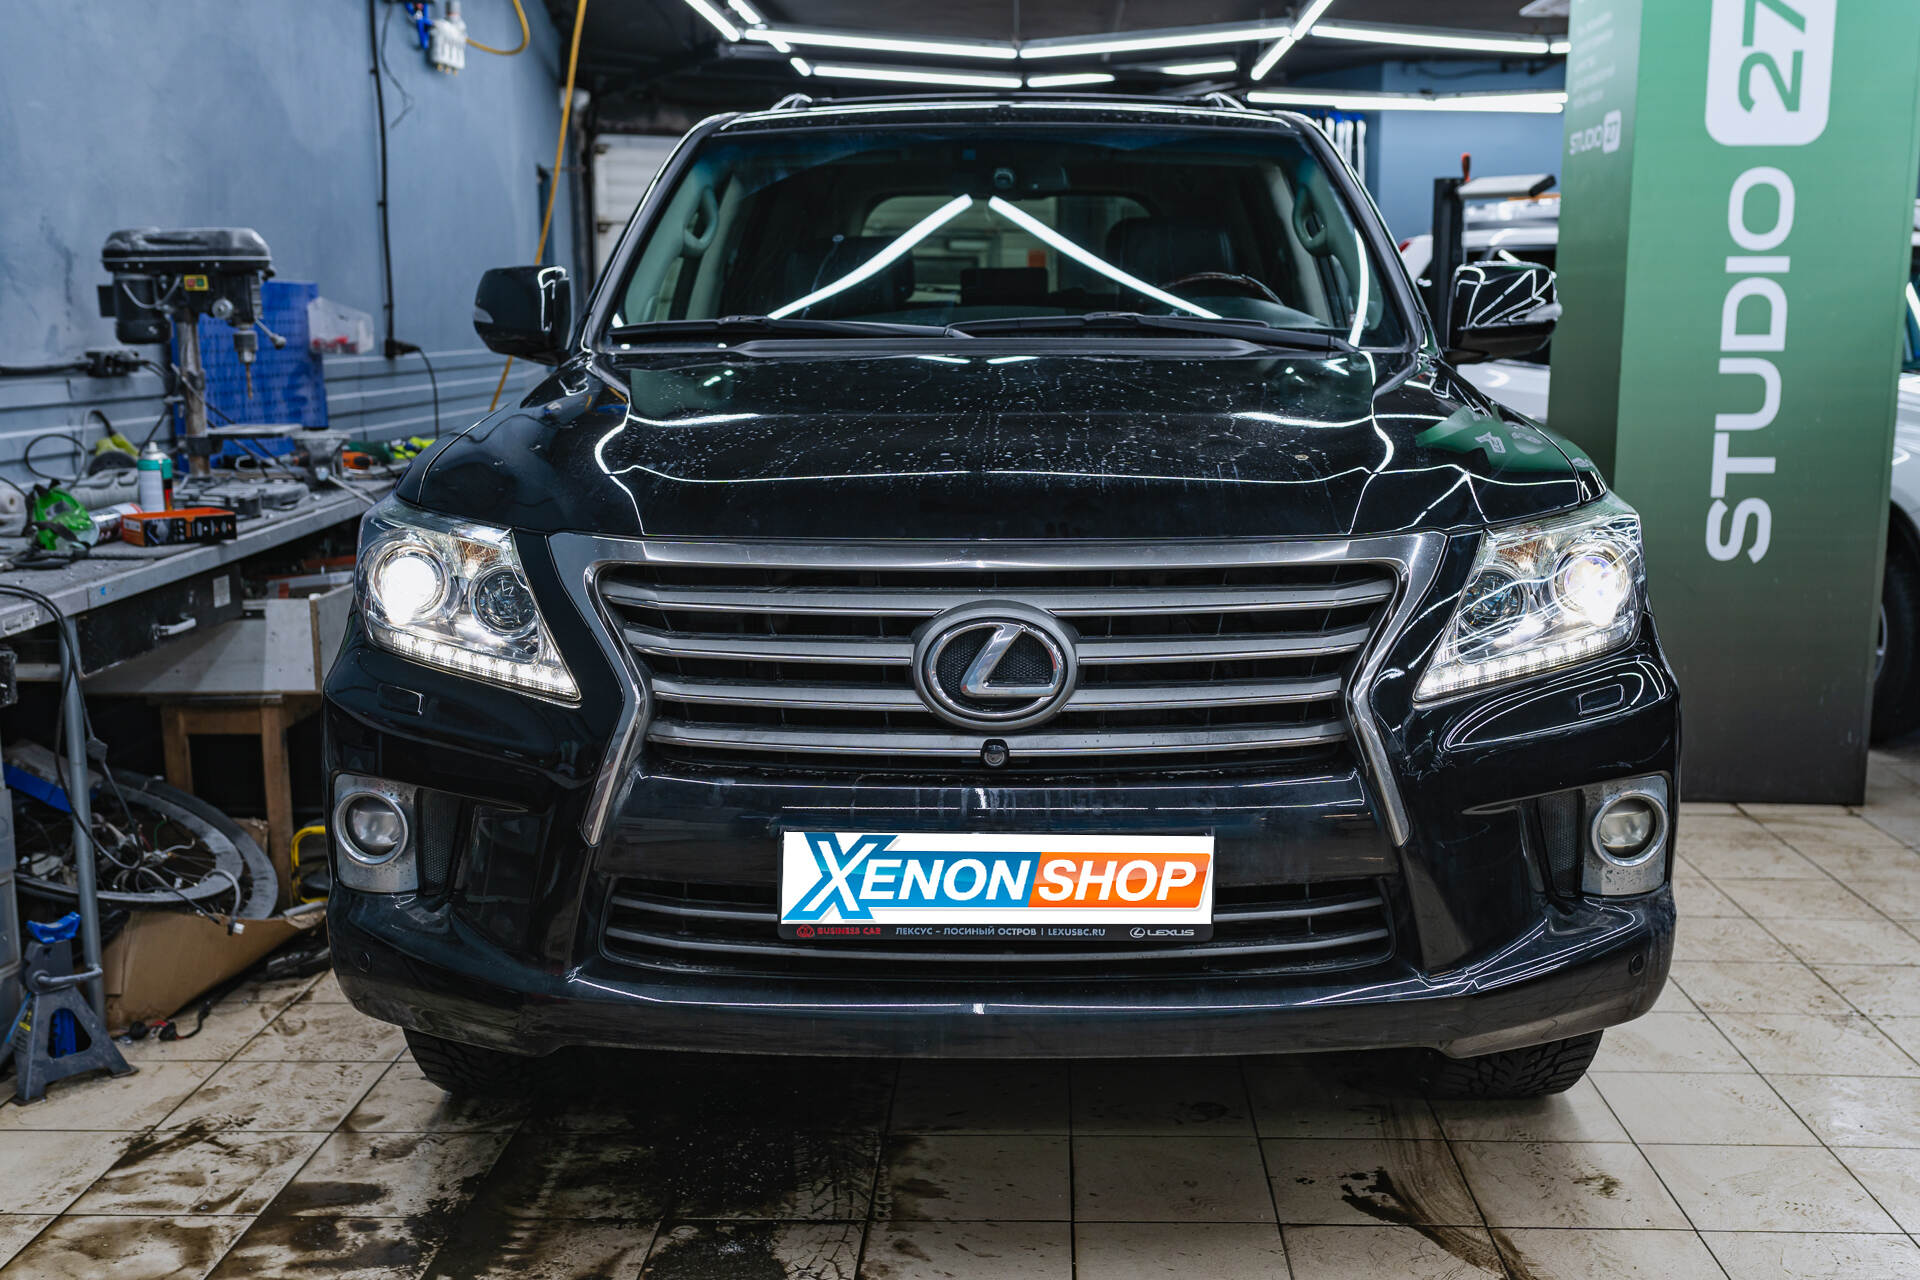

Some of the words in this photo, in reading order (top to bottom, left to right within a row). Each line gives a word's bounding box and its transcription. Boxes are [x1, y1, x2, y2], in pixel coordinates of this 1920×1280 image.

[1738, 0, 1806, 113] 27
[1705, 165, 1796, 564] STUDIO
[817, 927, 861, 936] BUSINESS
[895, 927, 933, 936] ЛЕКСУС
[943, 925, 995, 936] ЛОСИНЫЙ
[997, 927, 1037, 936] ОСТРОВ
[1048, 928, 1106, 937] LEXUSBC.RU
